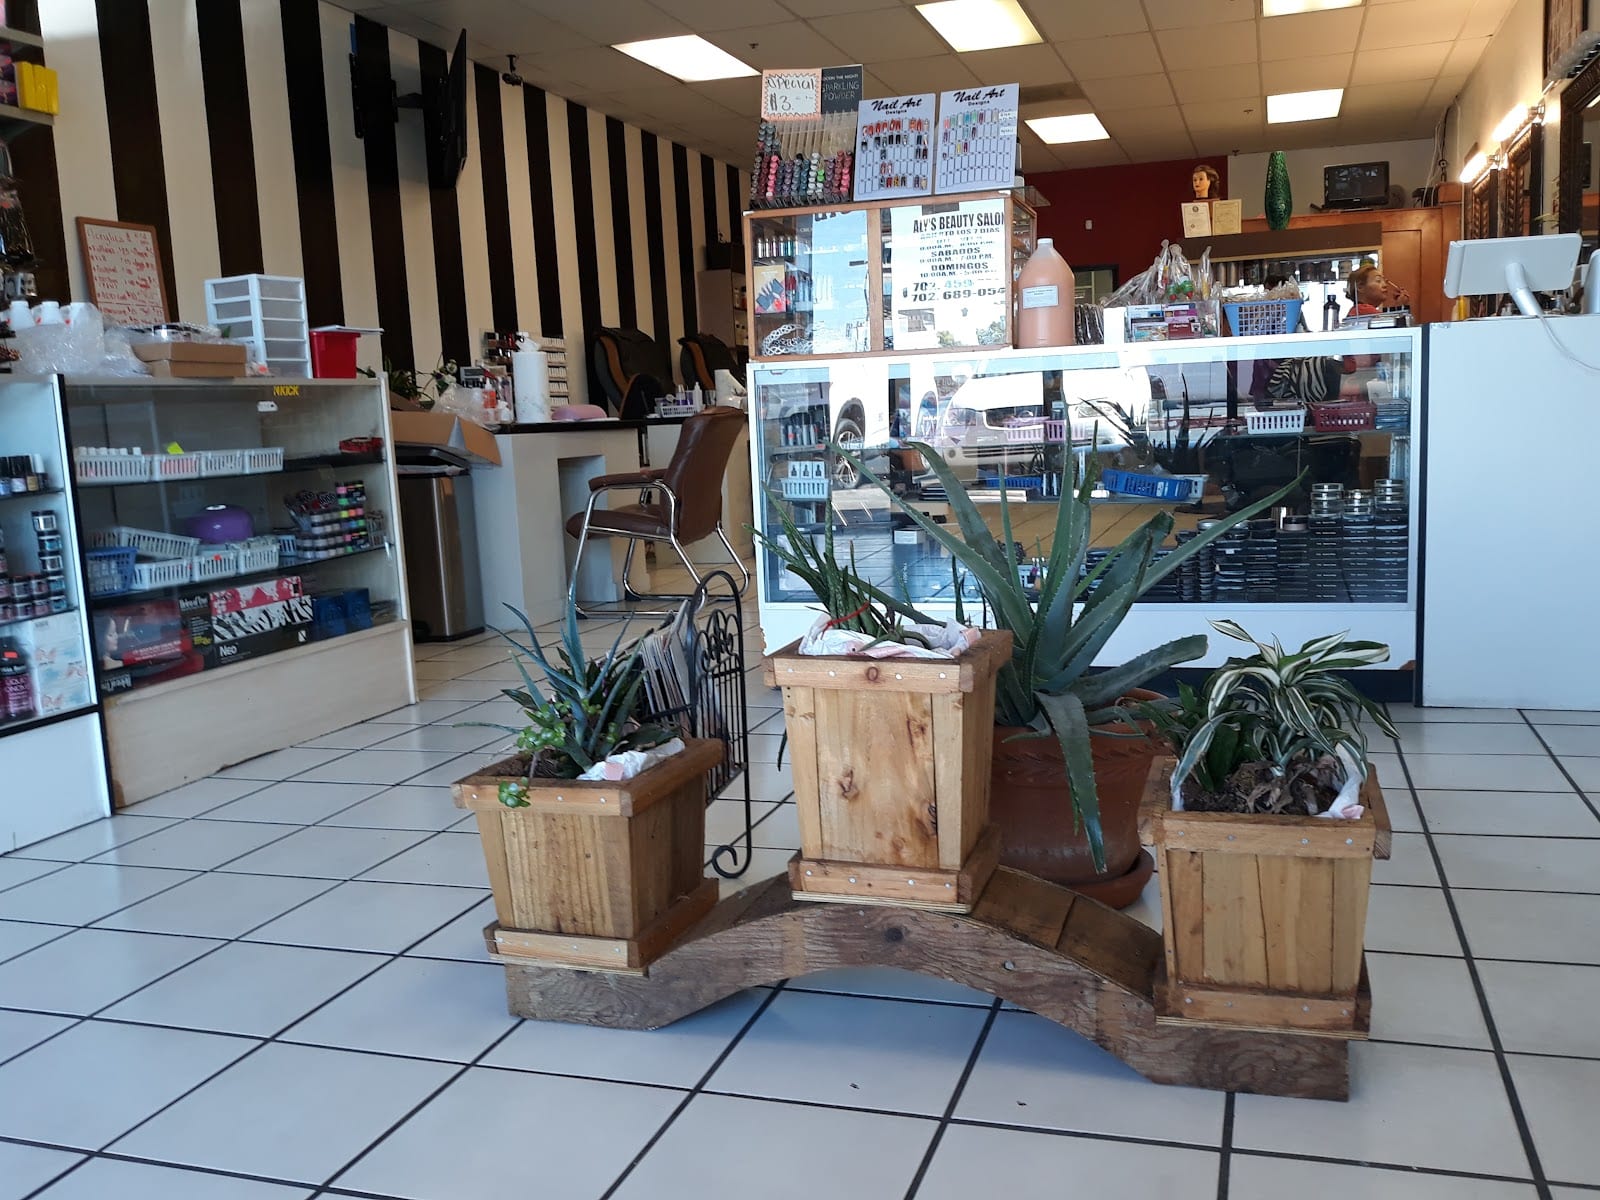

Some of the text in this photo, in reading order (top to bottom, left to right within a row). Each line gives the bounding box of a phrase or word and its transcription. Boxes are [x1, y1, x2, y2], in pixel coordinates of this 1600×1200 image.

[953, 88, 1006, 103] Nail Art
[872, 97, 923, 112] Nail Art
[913, 217, 937, 233] ALY'S
[939, 213, 975, 230] BEAUTY
[931, 247, 981, 257] SABADOS
[931, 262, 989, 271] DOMINGOS
